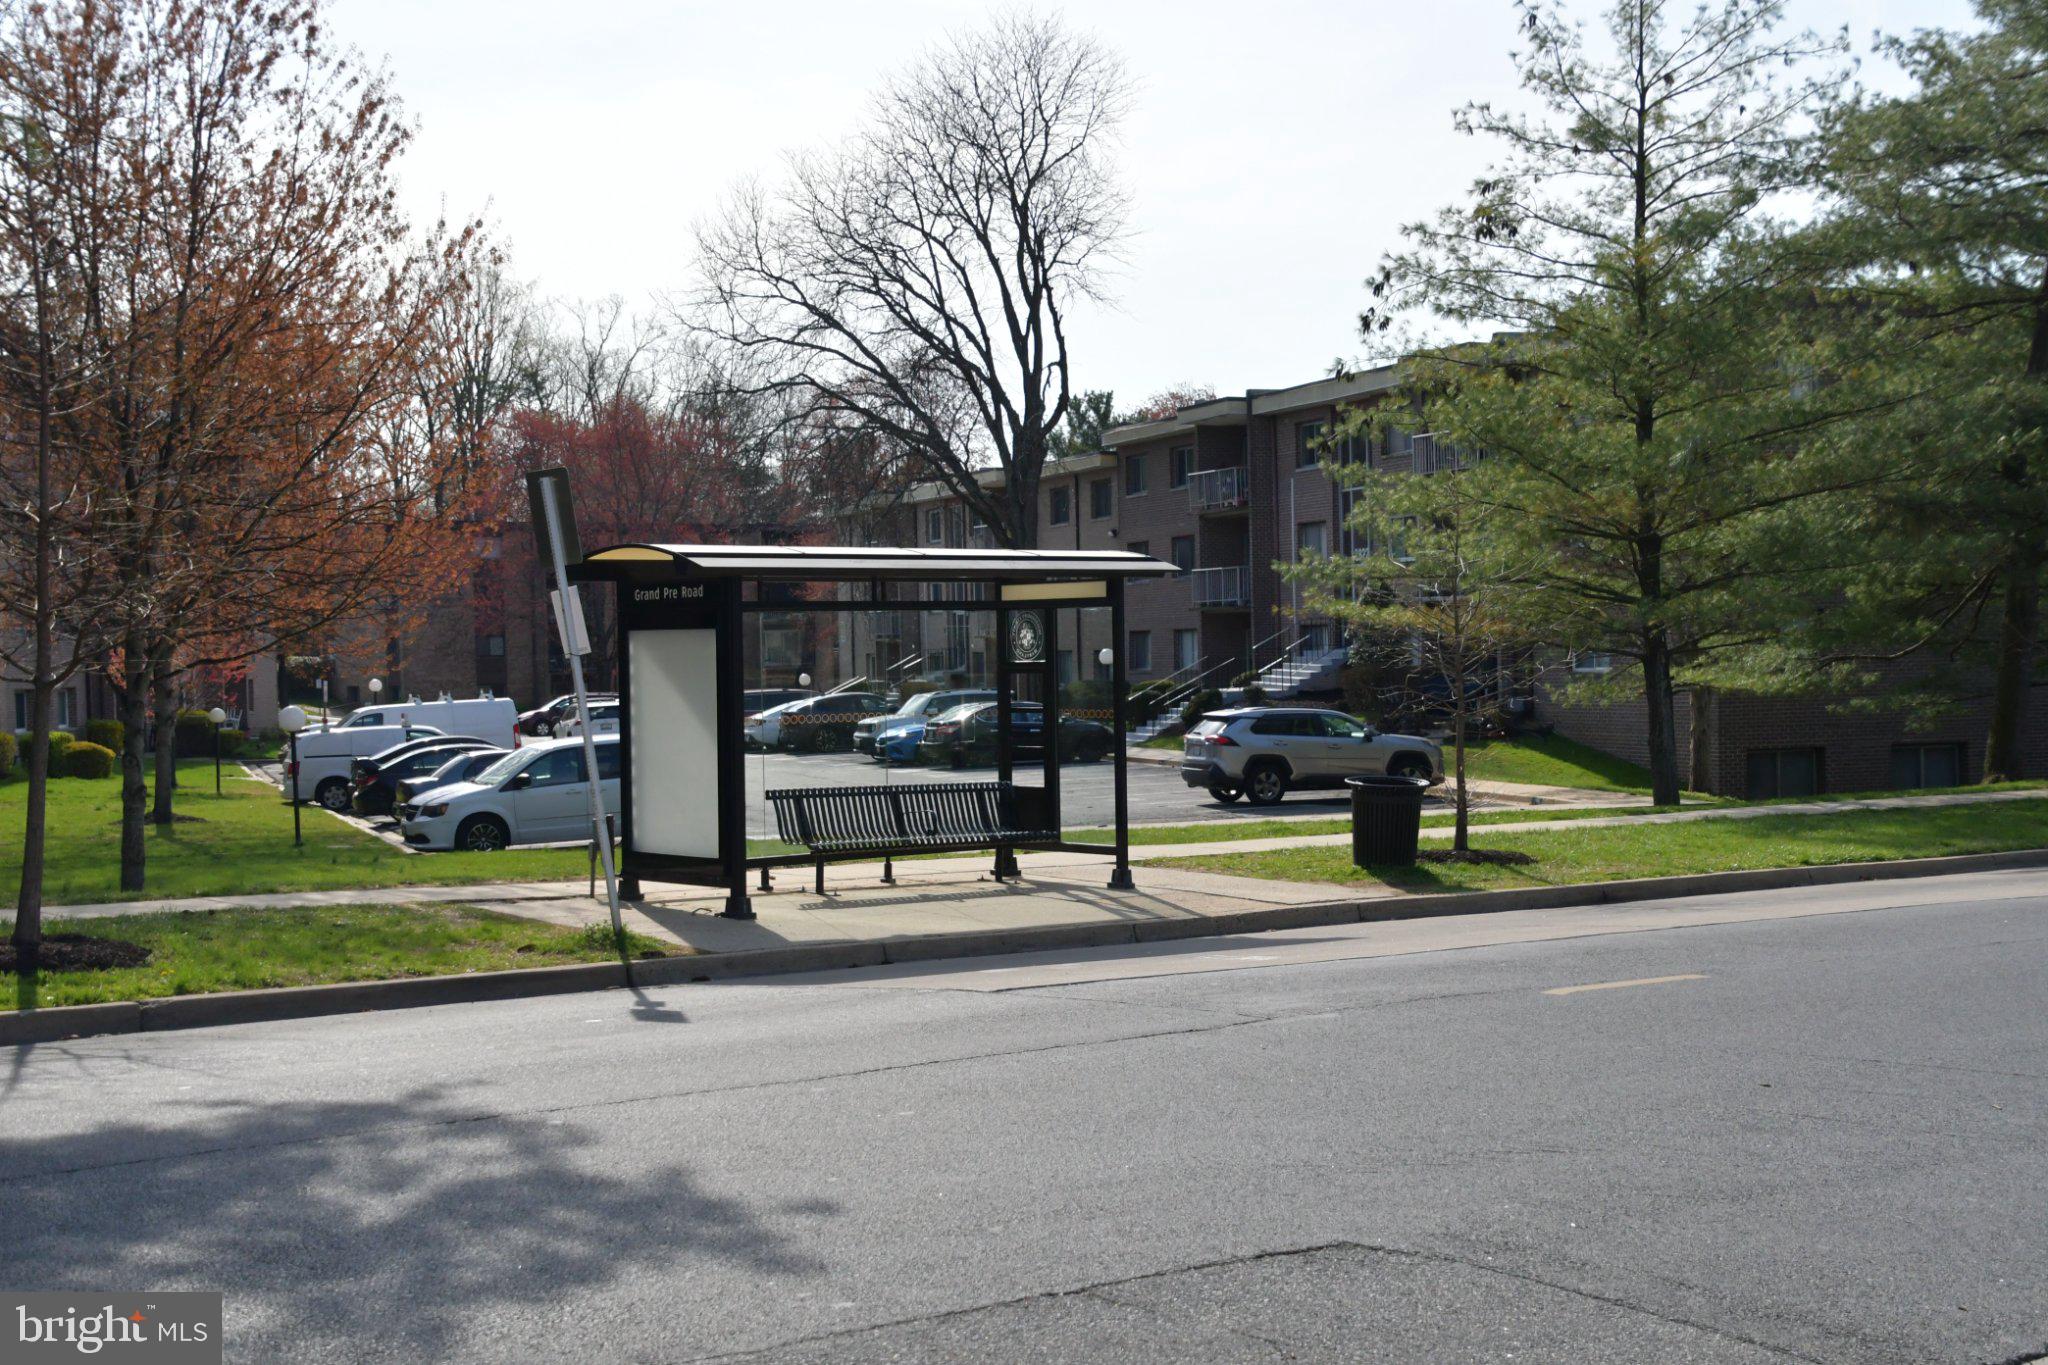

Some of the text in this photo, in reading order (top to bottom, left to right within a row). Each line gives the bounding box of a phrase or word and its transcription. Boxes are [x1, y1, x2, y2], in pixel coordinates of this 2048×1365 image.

[634, 584, 703, 601] Grand Pre Road
